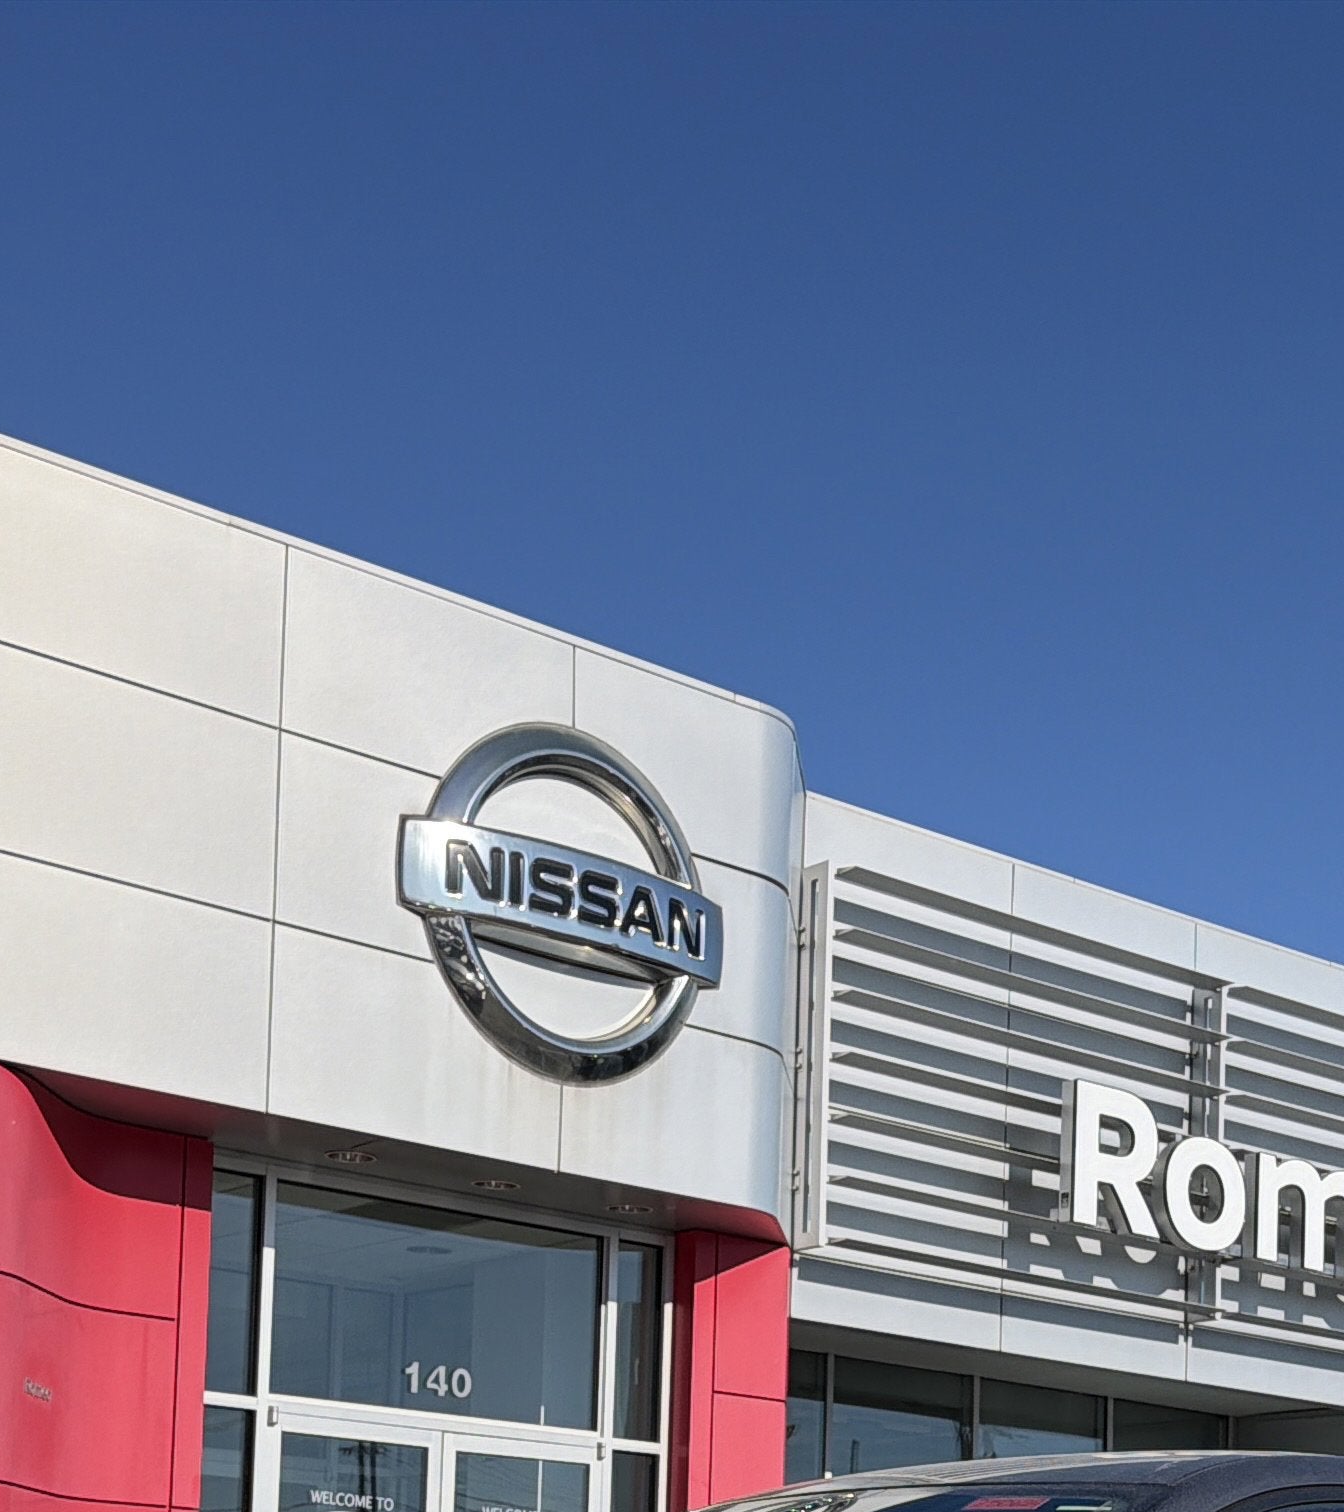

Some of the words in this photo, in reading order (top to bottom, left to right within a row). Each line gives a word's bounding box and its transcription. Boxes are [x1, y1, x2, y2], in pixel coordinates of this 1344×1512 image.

[444, 838, 706, 962] NISSAN
[404, 1360, 473, 1399] 140
[310, 1489, 373, 1510] WELCOME
[376, 1497, 395, 1512] TO
